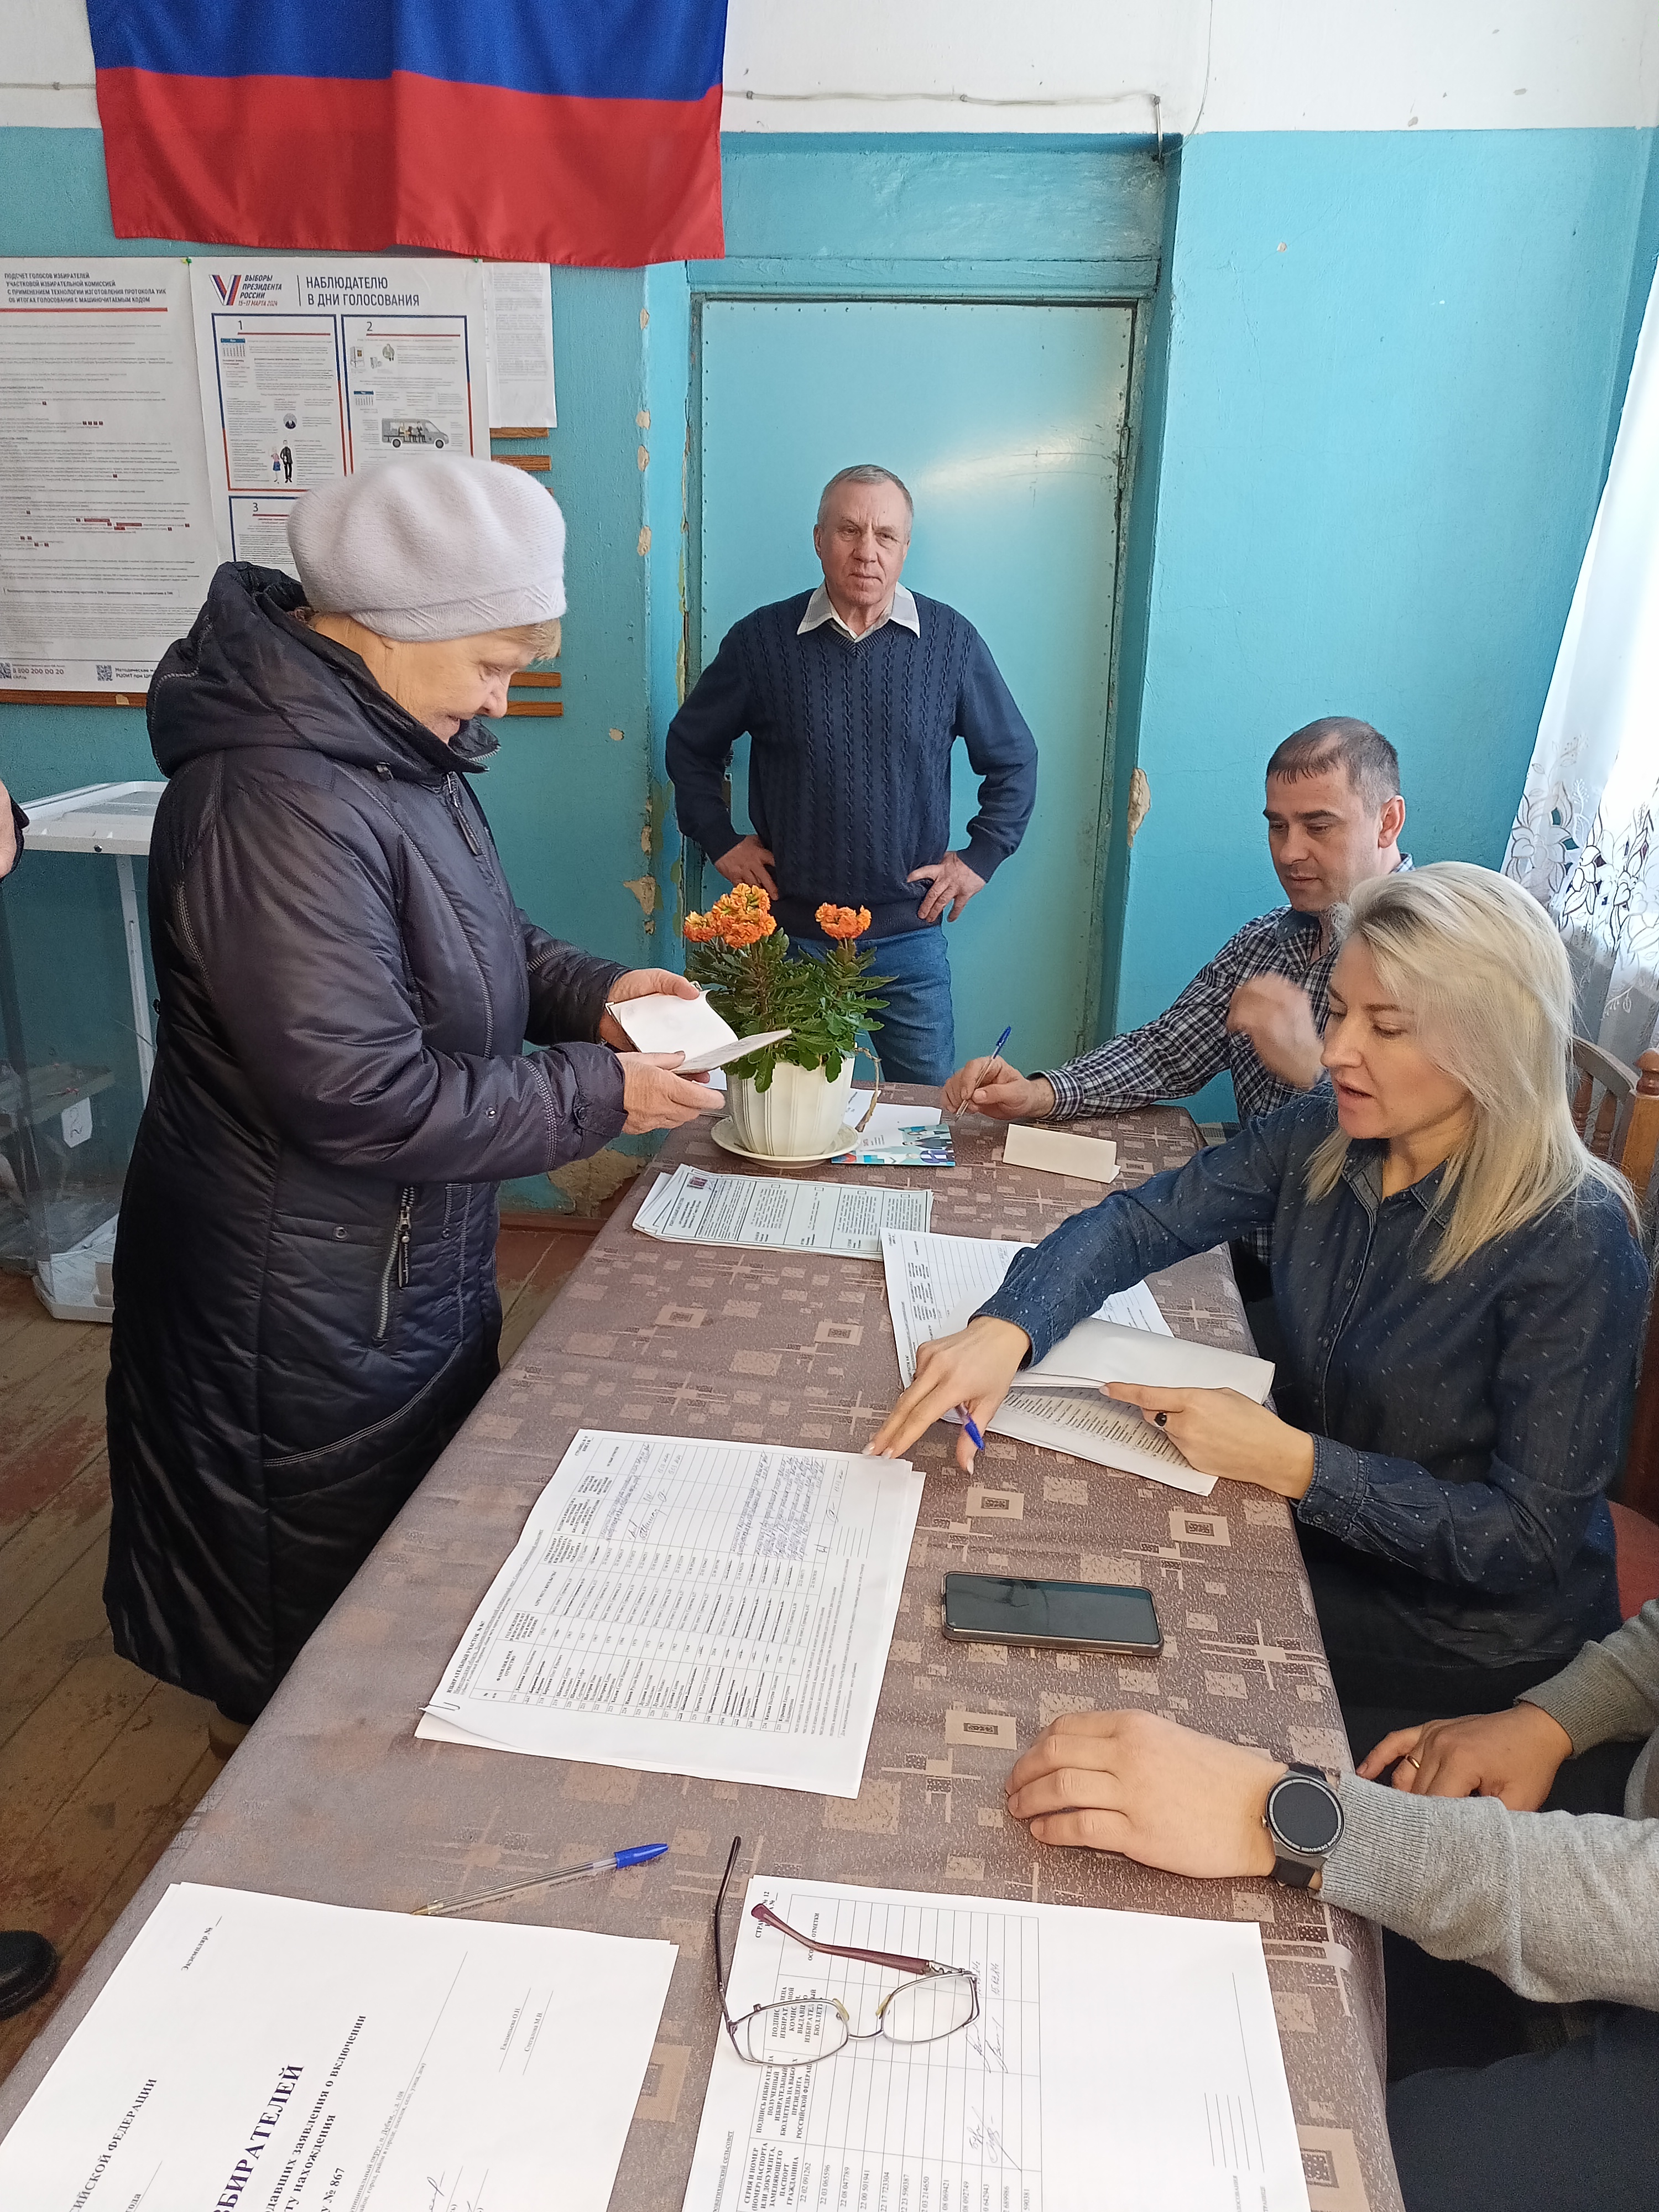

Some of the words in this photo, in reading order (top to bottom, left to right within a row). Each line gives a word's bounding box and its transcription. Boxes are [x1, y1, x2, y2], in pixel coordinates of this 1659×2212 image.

[306, 276, 388, 290] НАБЛЮДАТЕЛЮ
[307, 294, 314, 305] В
[317, 294, 340, 307] ДНИ
[343, 294, 420, 306] ГОЛОСОВАНИЯ
[238, 320, 242, 330] 1
[367, 321, 373, 331] 2
[253, 502, 258, 512] 3
[811, 1913, 820, 1938] ОТМЕТКИ
[181, 1936, 208, 1971] Экземпляр
[771, 2008, 780, 2037] ПОДПИС
[292, 2090, 330, 2155] заявления
[329, 2015, 366, 2077] включении
[395, 2091, 405, 2100] 108
[767, 2071, 780, 2116] ПОЛУЧЕННЫЙ
[791, 2077, 803, 2116] ПРЕЗИДЕНТА
[108, 2079, 157, 2151] ФЕДЕРАЦИИ
[756, 2101, 766, 2133] ПОДПИСЬ
[780, 2095, 791, 2136] БЮЛЛЕТЕНЬ
[786, 2086, 793, 2095] НА
[796, 2094, 808, 2139] РОССИЙСКОЙ
[293, 2115, 336, 2192] нахождения
[723, 2130, 734, 2164] сельсовет
[756, 2142, 768, 2181] ПАСПОРТА
[322, 2190, 336, 2204] №
[330, 2168, 345, 2187] 867
[744, 2180, 753, 2204] СЕРИЯ
[749, 2147, 759, 2173] НОМЕР
[763, 2146, 776, 2193] ДОКУМЕНТА,
[769, 2150, 783, 2207] ЗАМЕНЯЮЩЕГО
[779, 2163, 790, 2197] ПАСПОРТ
[786, 2157, 799, 2205] ГРАЖДАНИНА
[752, 2182, 763, 2211] (НОМЕР)
[760, 2193, 768, 2209] ИЛИ
